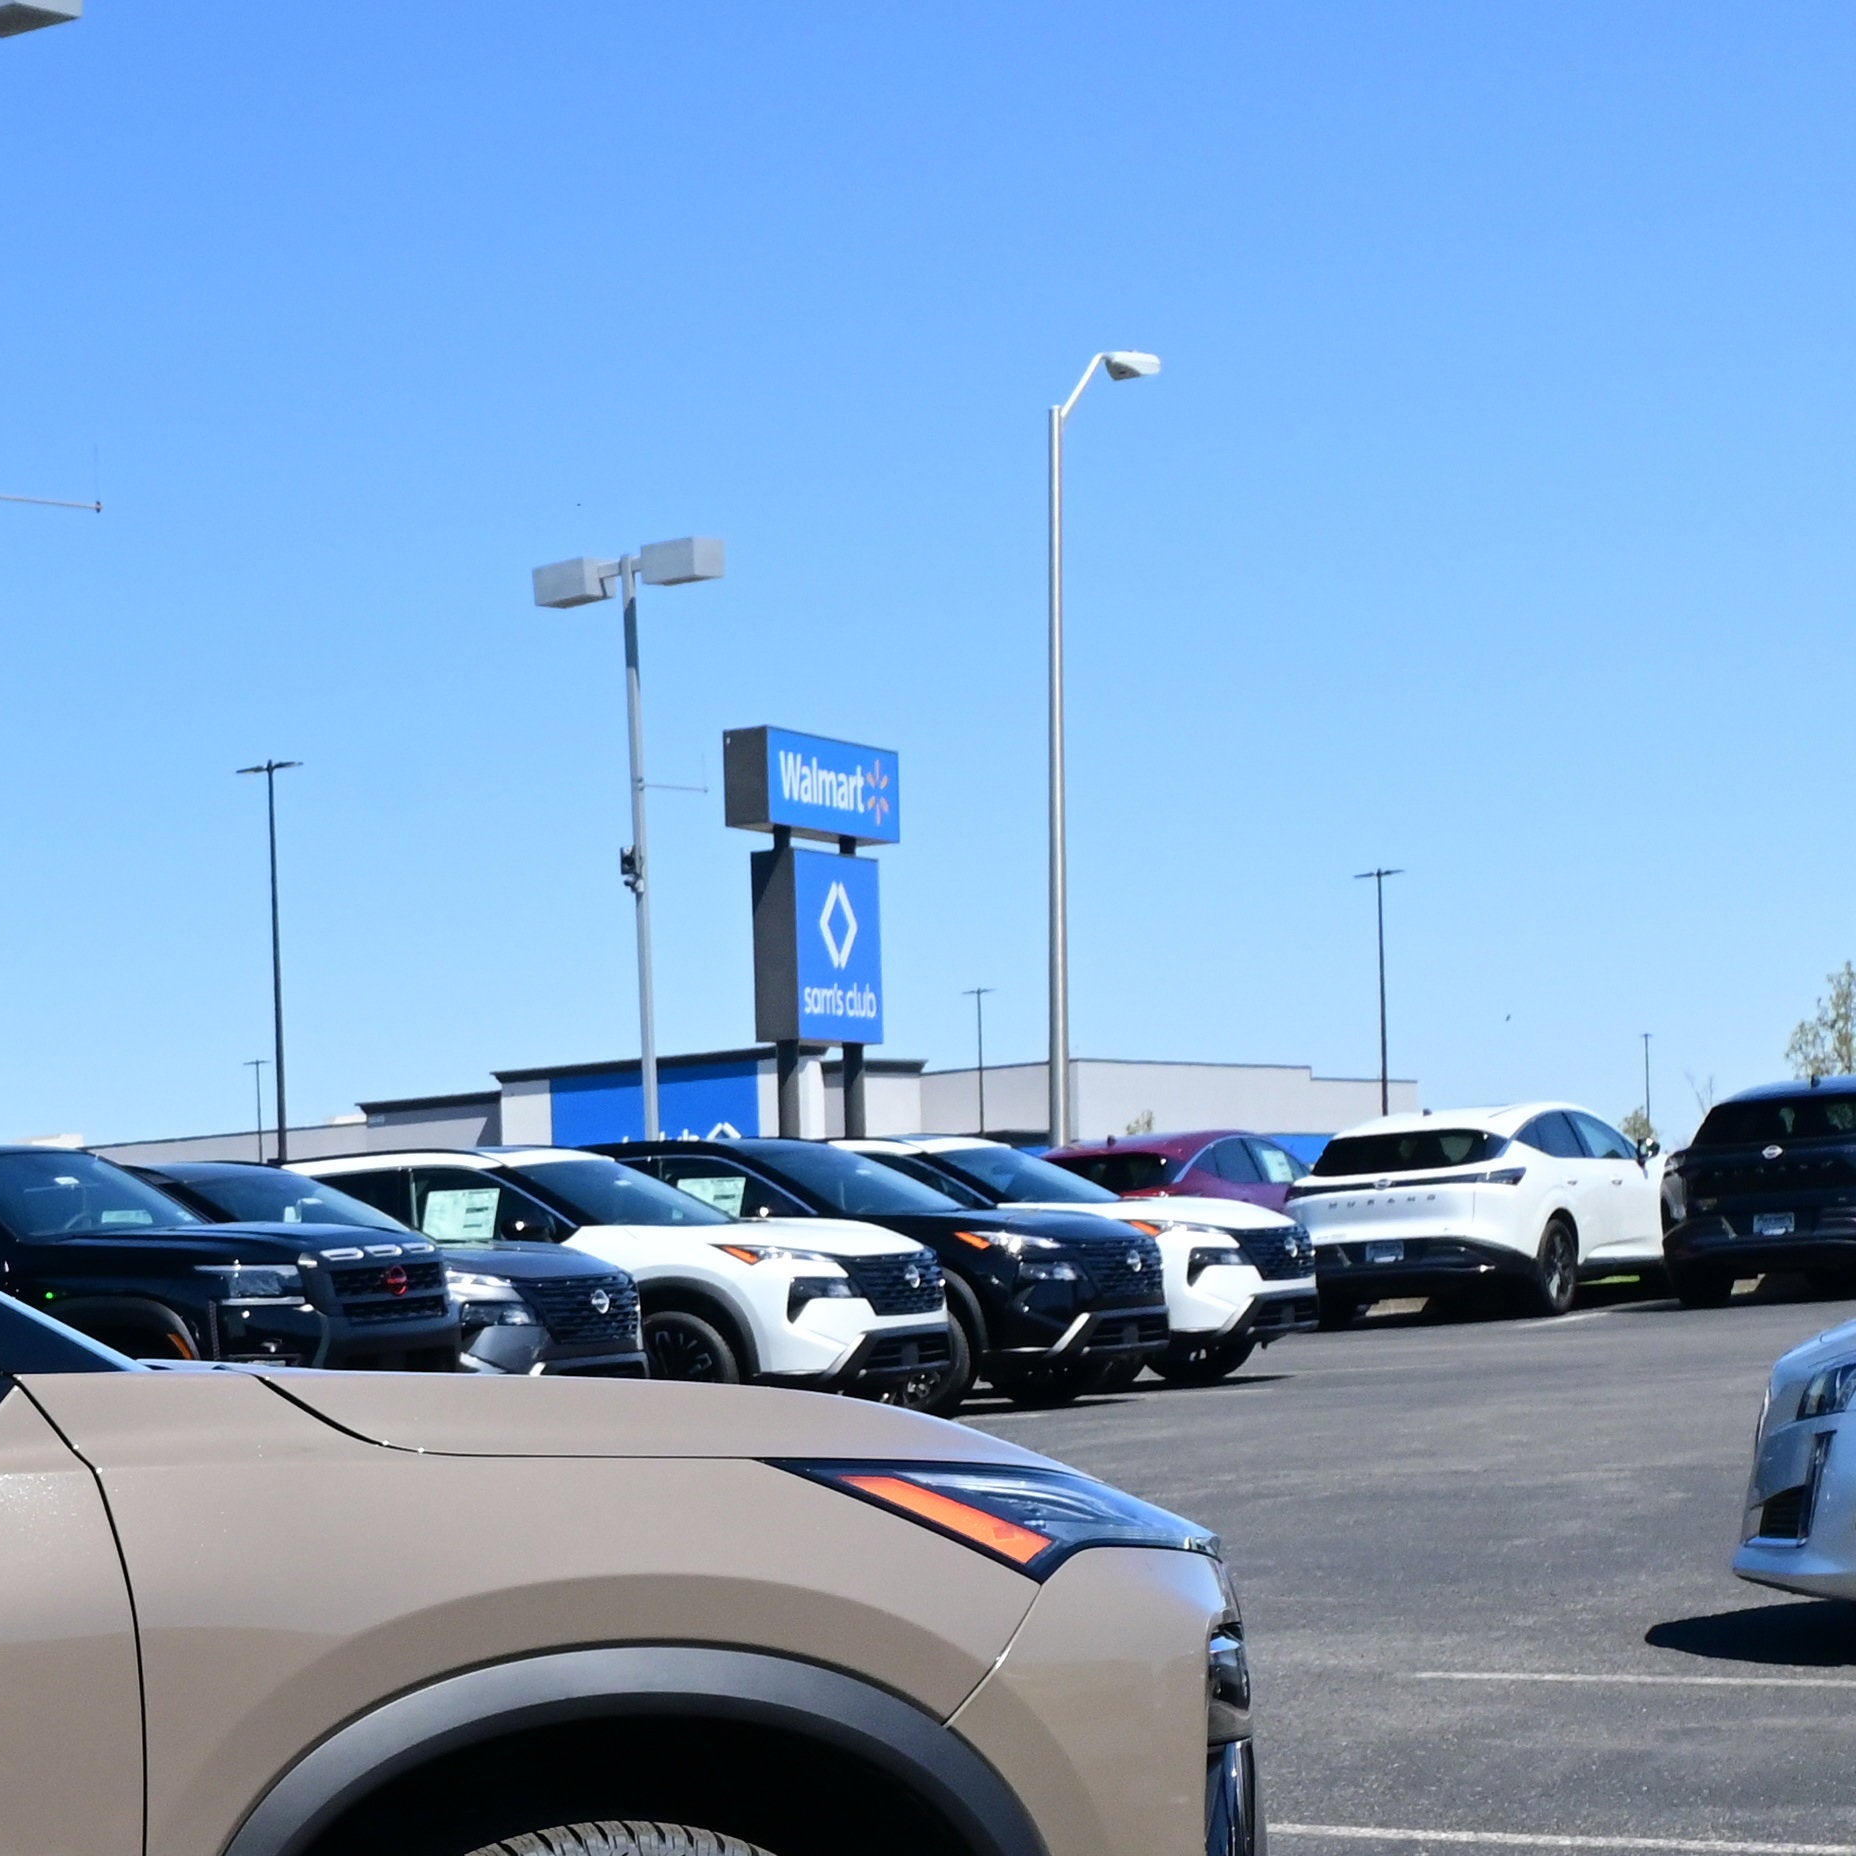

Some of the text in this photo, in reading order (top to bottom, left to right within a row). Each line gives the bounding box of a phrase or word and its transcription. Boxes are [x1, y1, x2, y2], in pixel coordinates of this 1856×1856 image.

[779, 750, 865, 814] Walmart
[804, 982, 877, 1018] sam's club
